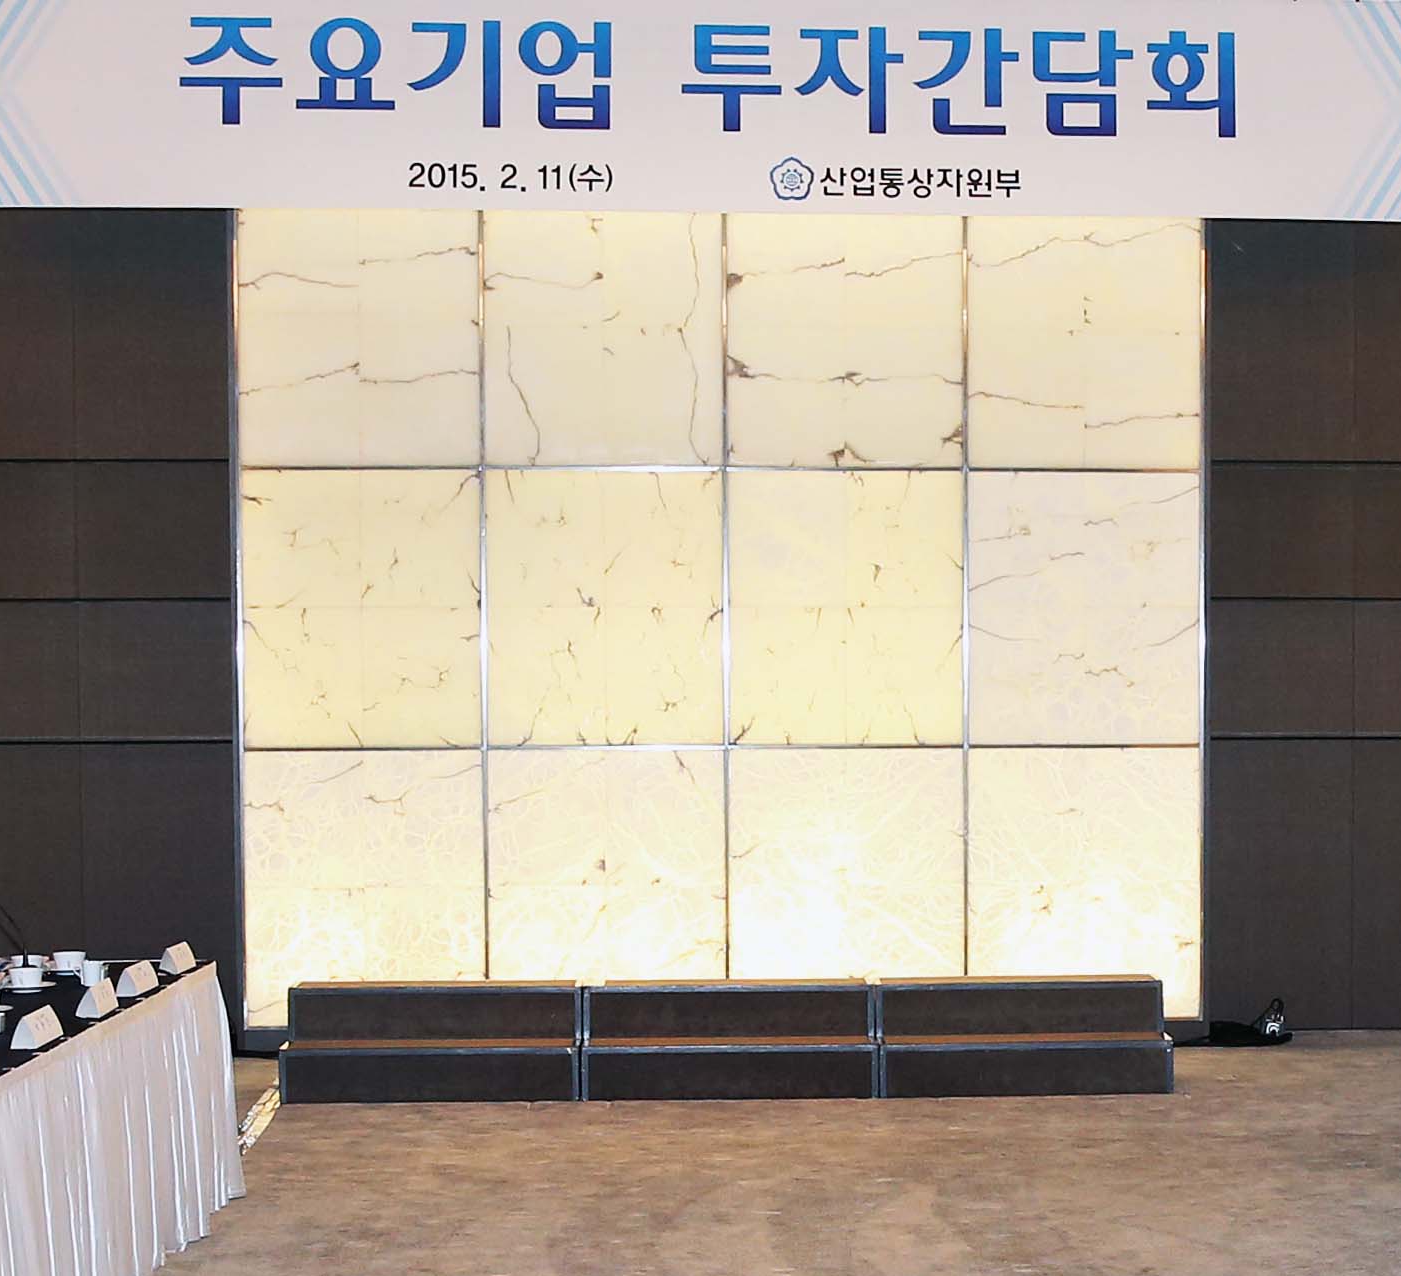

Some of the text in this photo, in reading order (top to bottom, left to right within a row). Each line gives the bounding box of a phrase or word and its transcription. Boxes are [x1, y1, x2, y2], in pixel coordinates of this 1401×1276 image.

[179, 16, 1237, 138] 주요기업 투자간담회
[407, 162, 614, 193] 2015. 2. 11(수)
[819, 166, 1022, 198] 산업통상자원부
